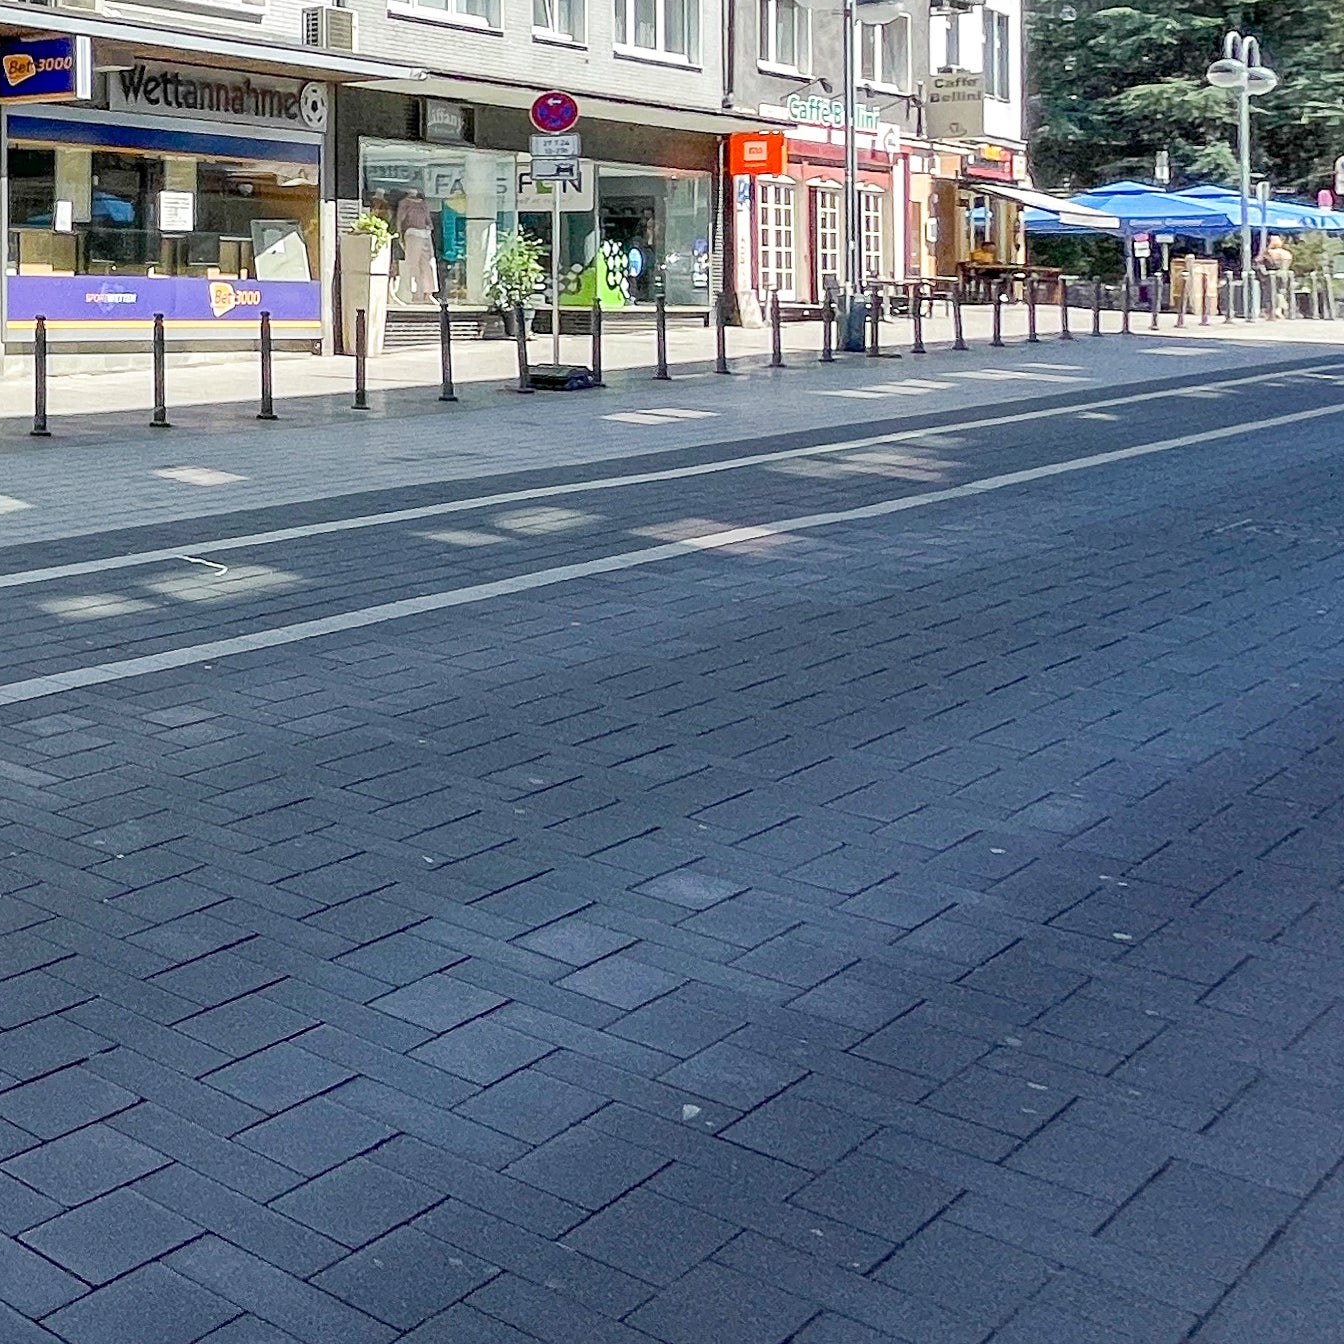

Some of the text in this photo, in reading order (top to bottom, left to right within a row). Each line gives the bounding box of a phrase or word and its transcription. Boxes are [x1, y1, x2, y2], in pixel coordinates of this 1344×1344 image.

[7, 56, 73, 75] Bet 3000
[119, 64, 299, 121] Wettannahme
[214, 289, 261, 306] Bet 3000
